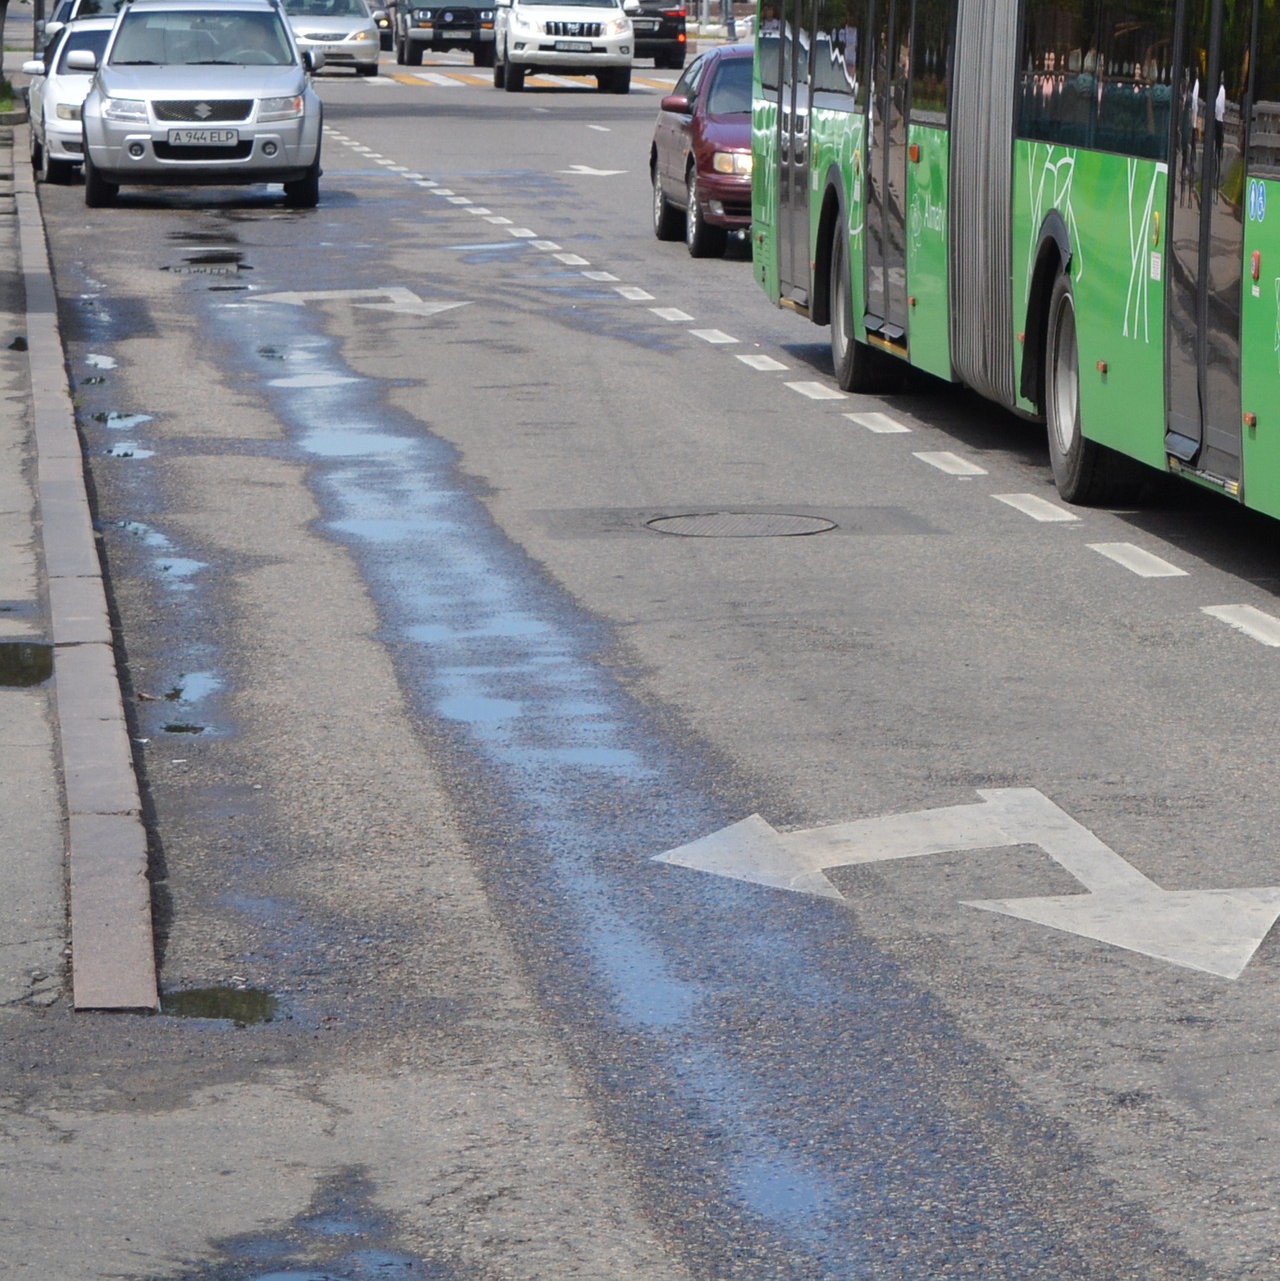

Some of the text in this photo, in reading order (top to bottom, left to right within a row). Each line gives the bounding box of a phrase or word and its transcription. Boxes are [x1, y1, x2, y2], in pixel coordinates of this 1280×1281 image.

[174, 131, 234, 143] A 944 ELP
